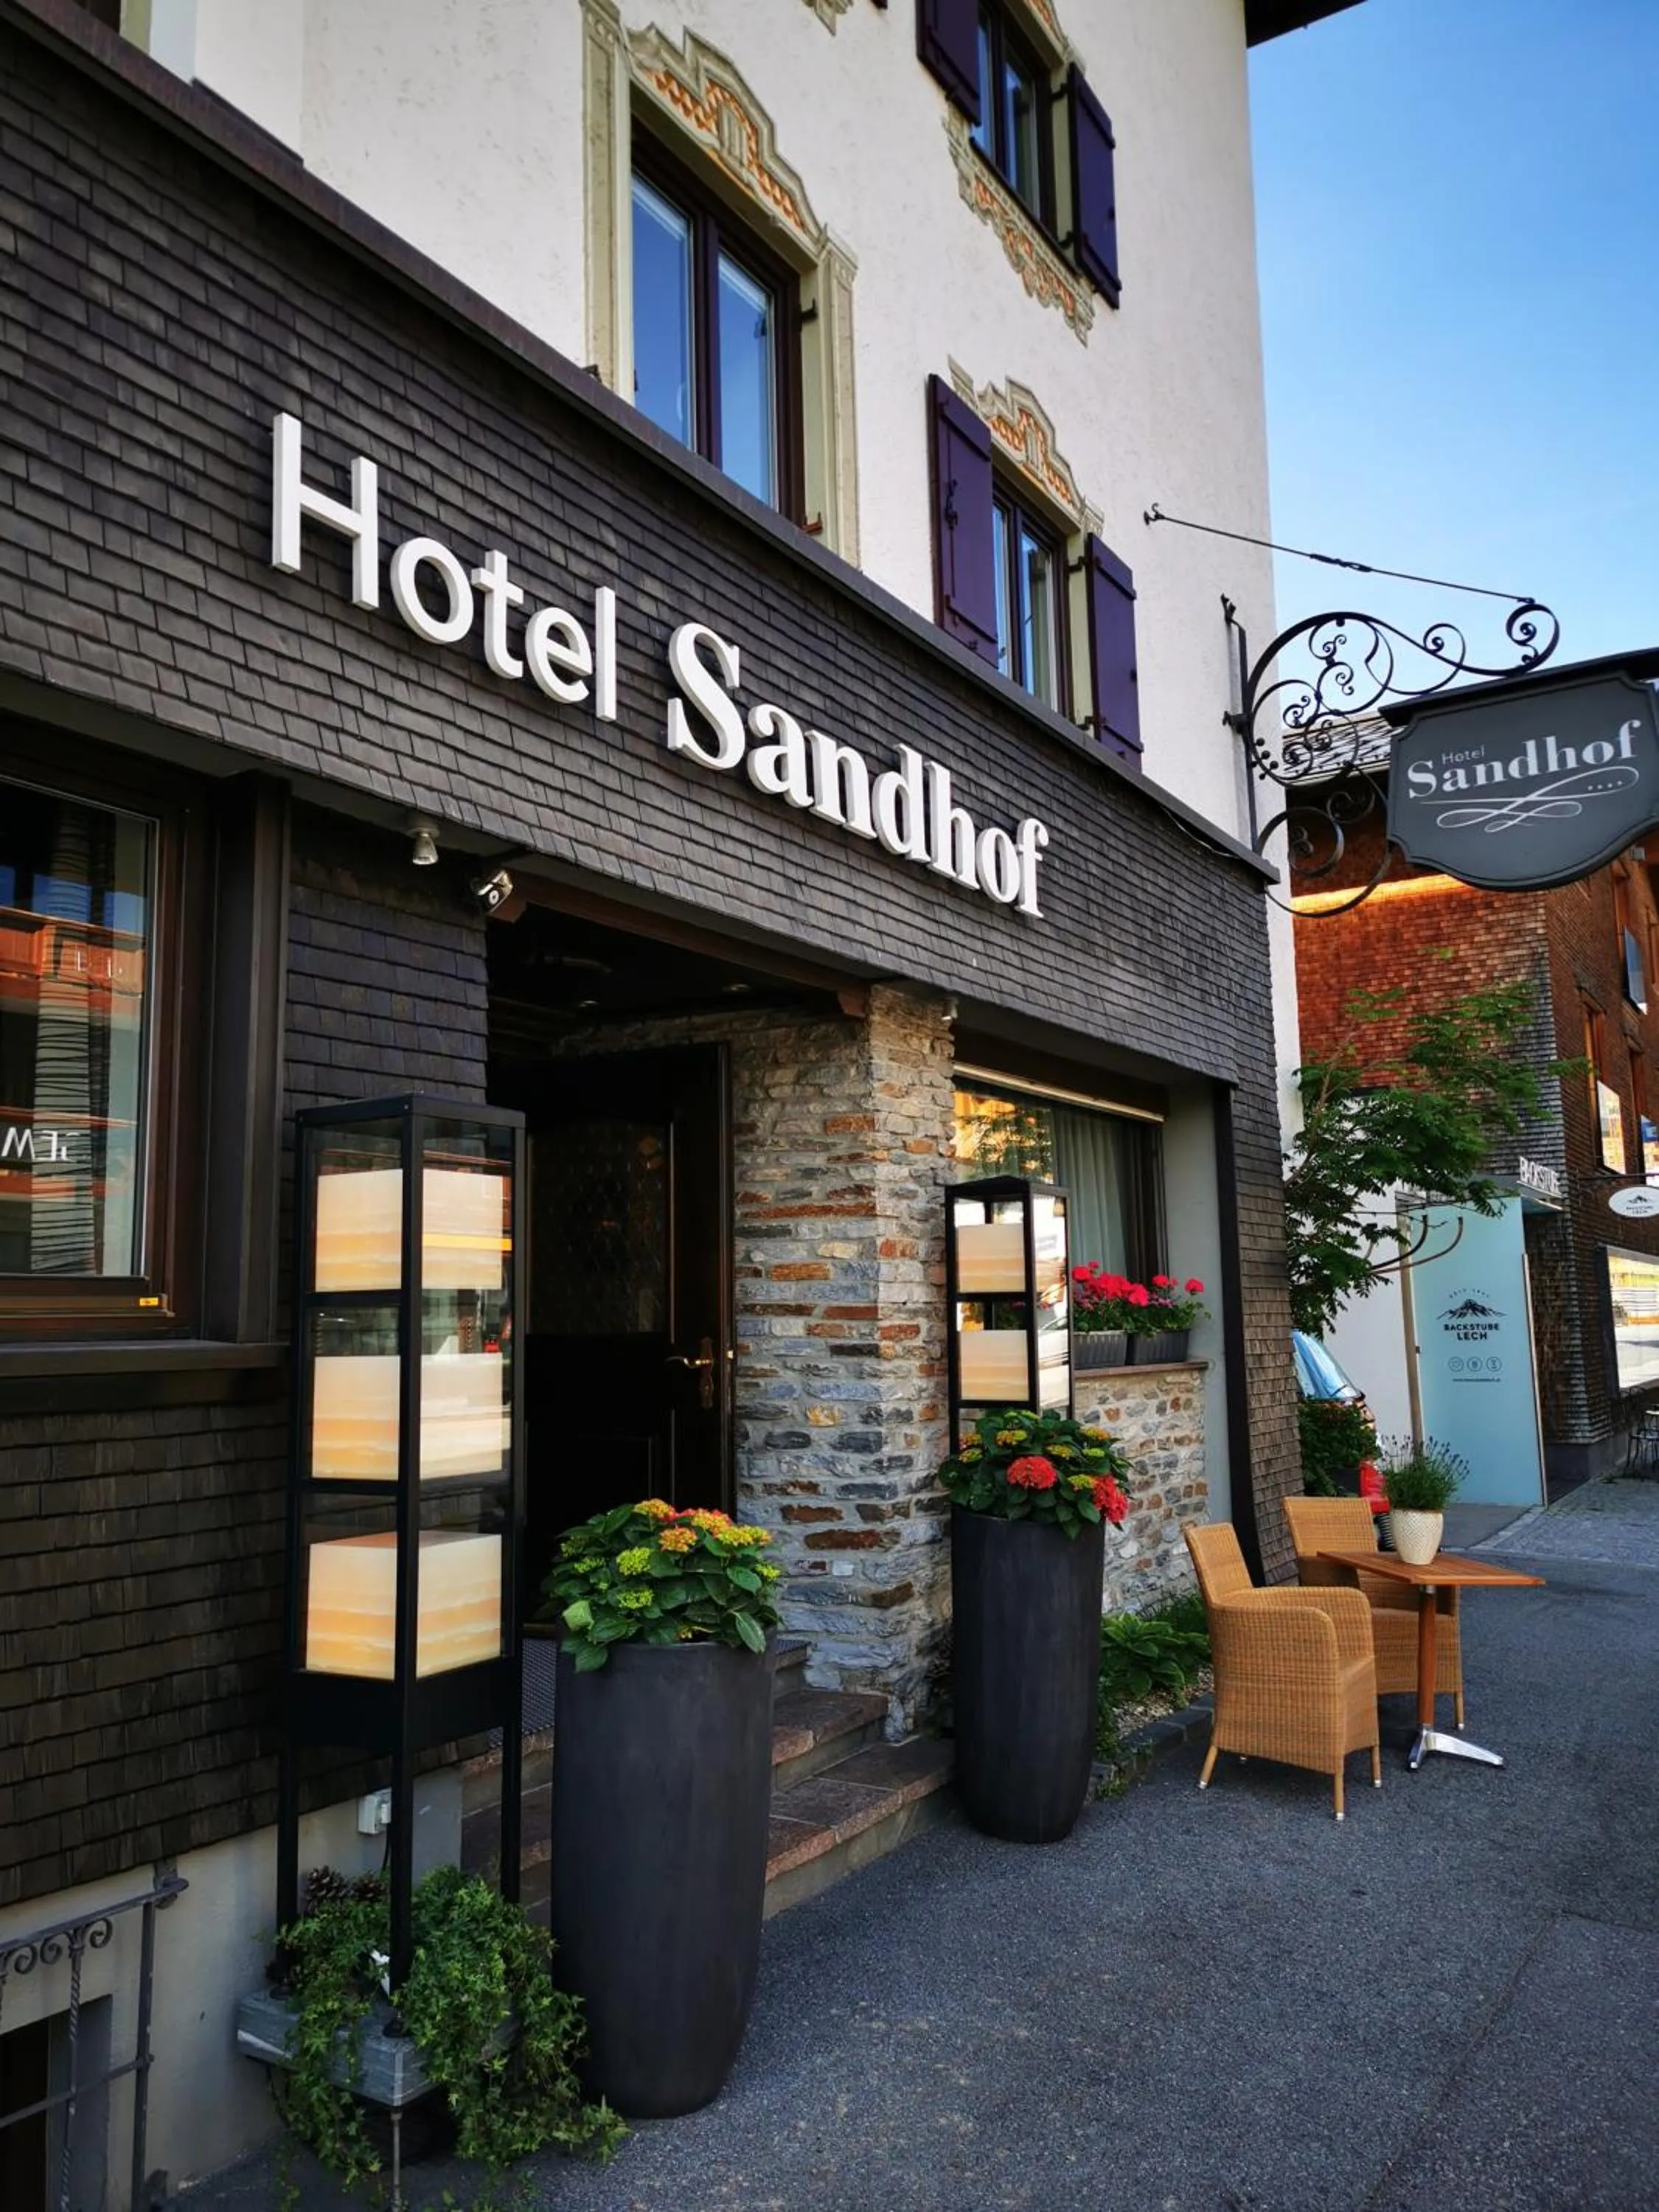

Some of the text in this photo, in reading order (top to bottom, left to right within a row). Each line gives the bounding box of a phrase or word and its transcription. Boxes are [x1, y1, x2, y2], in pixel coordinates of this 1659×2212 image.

[273, 411, 1050, 919] Hotel Sandhof
[1407, 719, 1641, 799] Sandhof
[1441, 745, 1486, 765] Hotel
[1456, 1332, 1488, 1341] LECH
